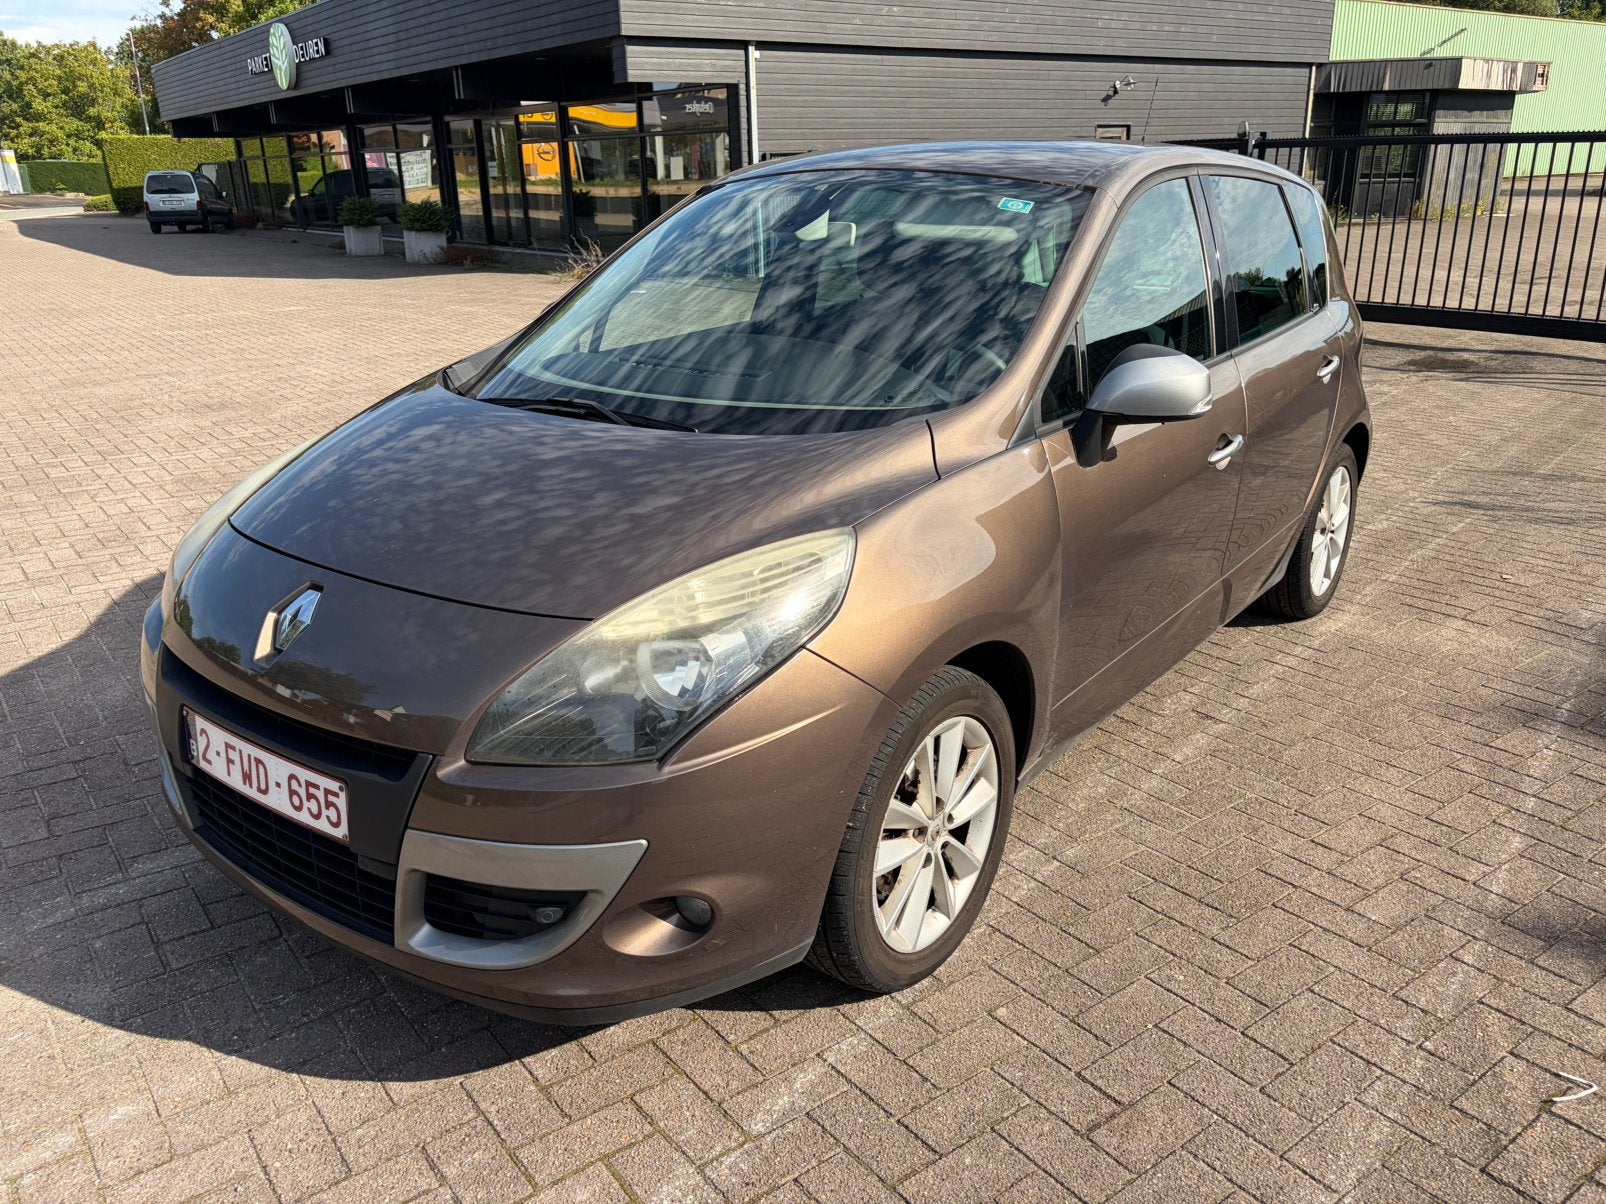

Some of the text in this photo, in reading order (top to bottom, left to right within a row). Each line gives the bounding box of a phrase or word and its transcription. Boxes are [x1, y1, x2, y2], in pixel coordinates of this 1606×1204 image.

[247, 37, 325, 75] PARKET DEUREN
[190, 738, 198, 756] B
[199, 727, 342, 829] 2-FWD-655
